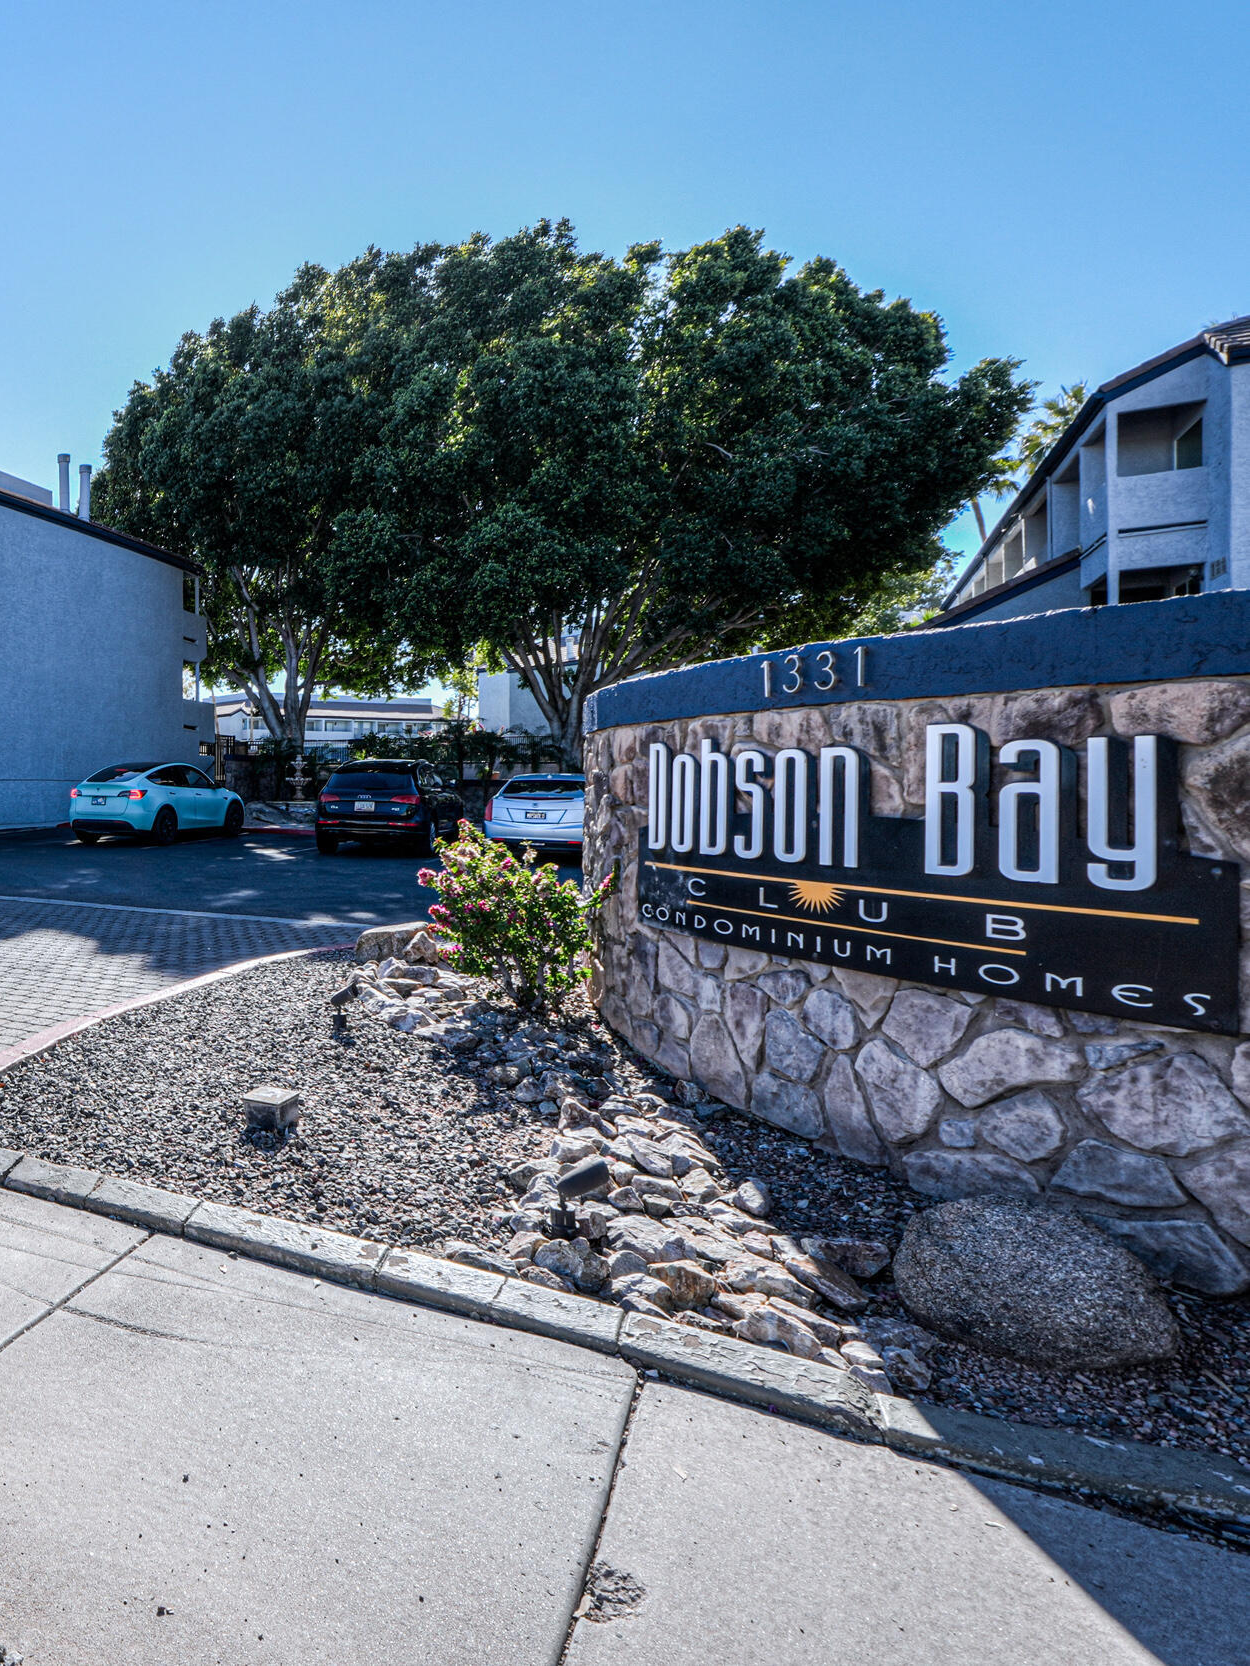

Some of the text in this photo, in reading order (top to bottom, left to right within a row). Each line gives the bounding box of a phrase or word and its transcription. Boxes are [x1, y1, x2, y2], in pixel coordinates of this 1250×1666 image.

[760, 646, 867, 698] 1331
[648, 723, 1157, 891] Dobson Bay
[687, 877, 1027, 941] CLUB
[641, 903, 1211, 1016] CONDOMINIUM HOMES
